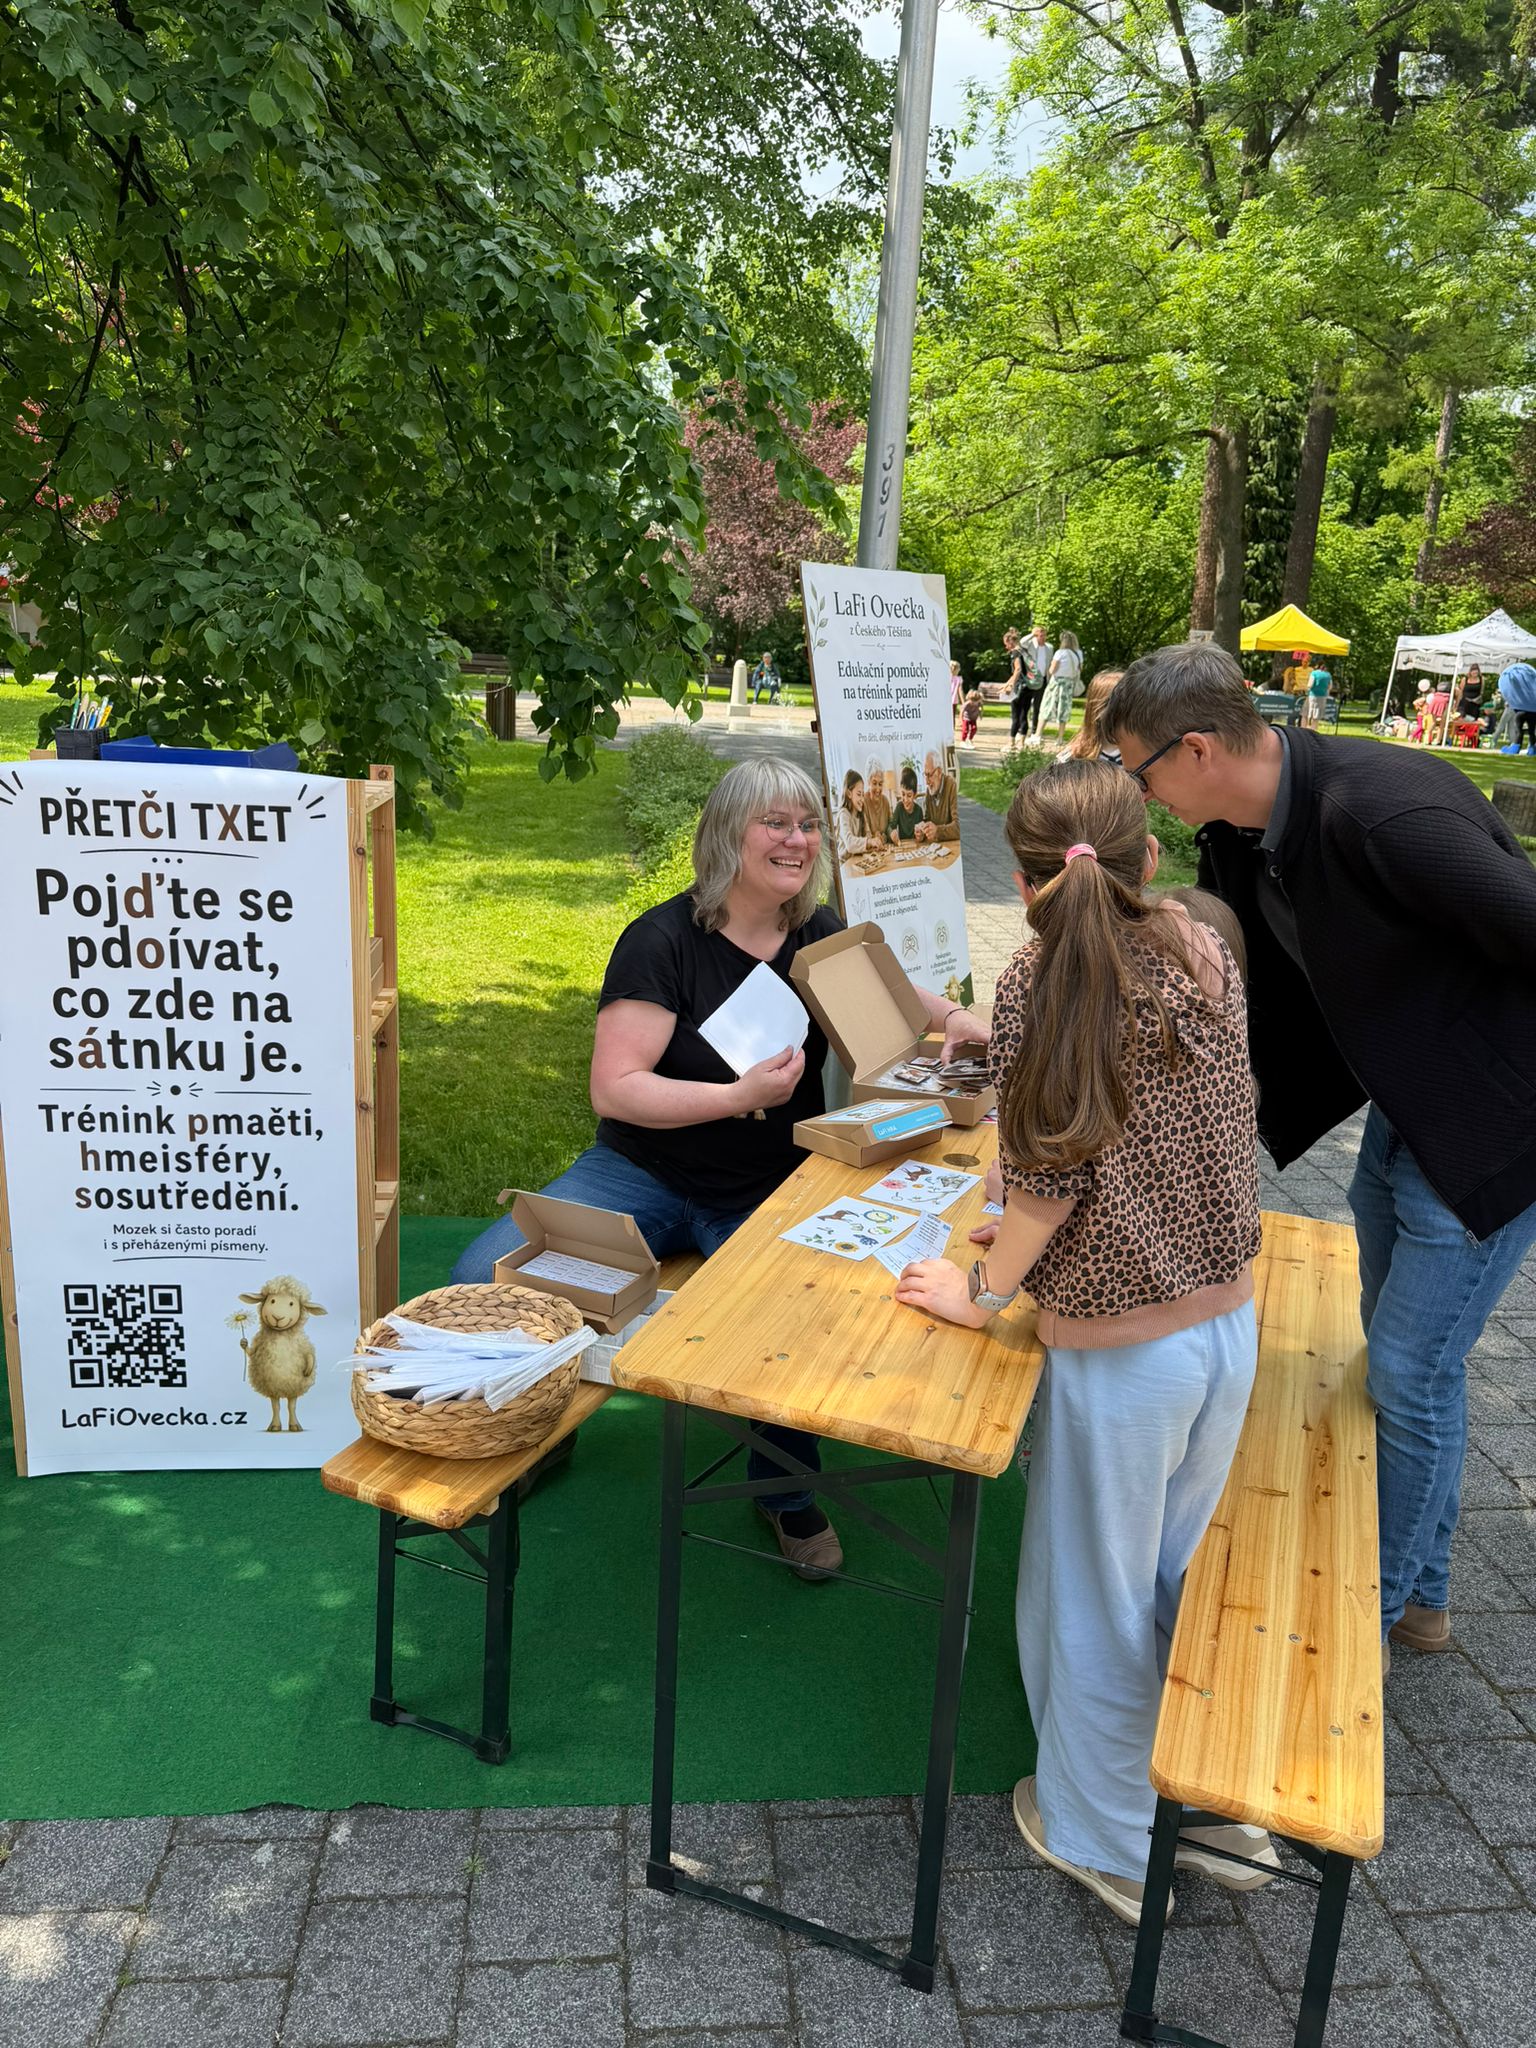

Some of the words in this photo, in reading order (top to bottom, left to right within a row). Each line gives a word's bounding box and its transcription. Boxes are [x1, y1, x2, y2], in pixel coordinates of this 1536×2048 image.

[833, 591, 866, 617] LaFi
[870, 594, 926, 620] Ovečka
[854, 622, 886, 637] Českého
[886, 625, 912, 638] Těšína
[837, 660, 884, 678] Edukační
[887, 662, 930, 682] pomůcky
[843, 687, 856, 700] na
[858, 683, 894, 700] trénink
[895, 684, 928, 702] paměti
[857, 709, 863, 720] a
[864, 704, 921, 721] soustředění
[40, 787, 177, 839] PŘETČI
[190, 803, 292, 842] TXET
[35, 868, 221, 928] Pojďte
[239, 888, 293, 922] se
[68, 925, 280, 979] pdoívat,
[52, 986, 110, 1019] co
[128, 977, 215, 1021] zde
[232, 992, 292, 1023] na
[49, 1026, 225, 1071] sátnku
[239, 1030, 302, 1082] je.
[38, 1103, 176, 1134] Trénink
[188, 1107, 324, 1142] pmaěti,
[80, 1141, 282, 1179] hmeisféry,
[75, 1180, 300, 1212] sosutředění.
[103, 1239, 107, 1249] i
[111, 1241, 118, 1250] s
[122, 1238, 207, 1252] přeházenými
[211, 1240, 269, 1253] písmeny.
[113, 1224, 157, 1235] Mozek
[161, 1224, 171, 1235] si
[175, 1224, 211, 1235] často
[214, 1225, 256, 1238] poradí
[61, 1406, 248, 1428] LaFiOvecka.cz
